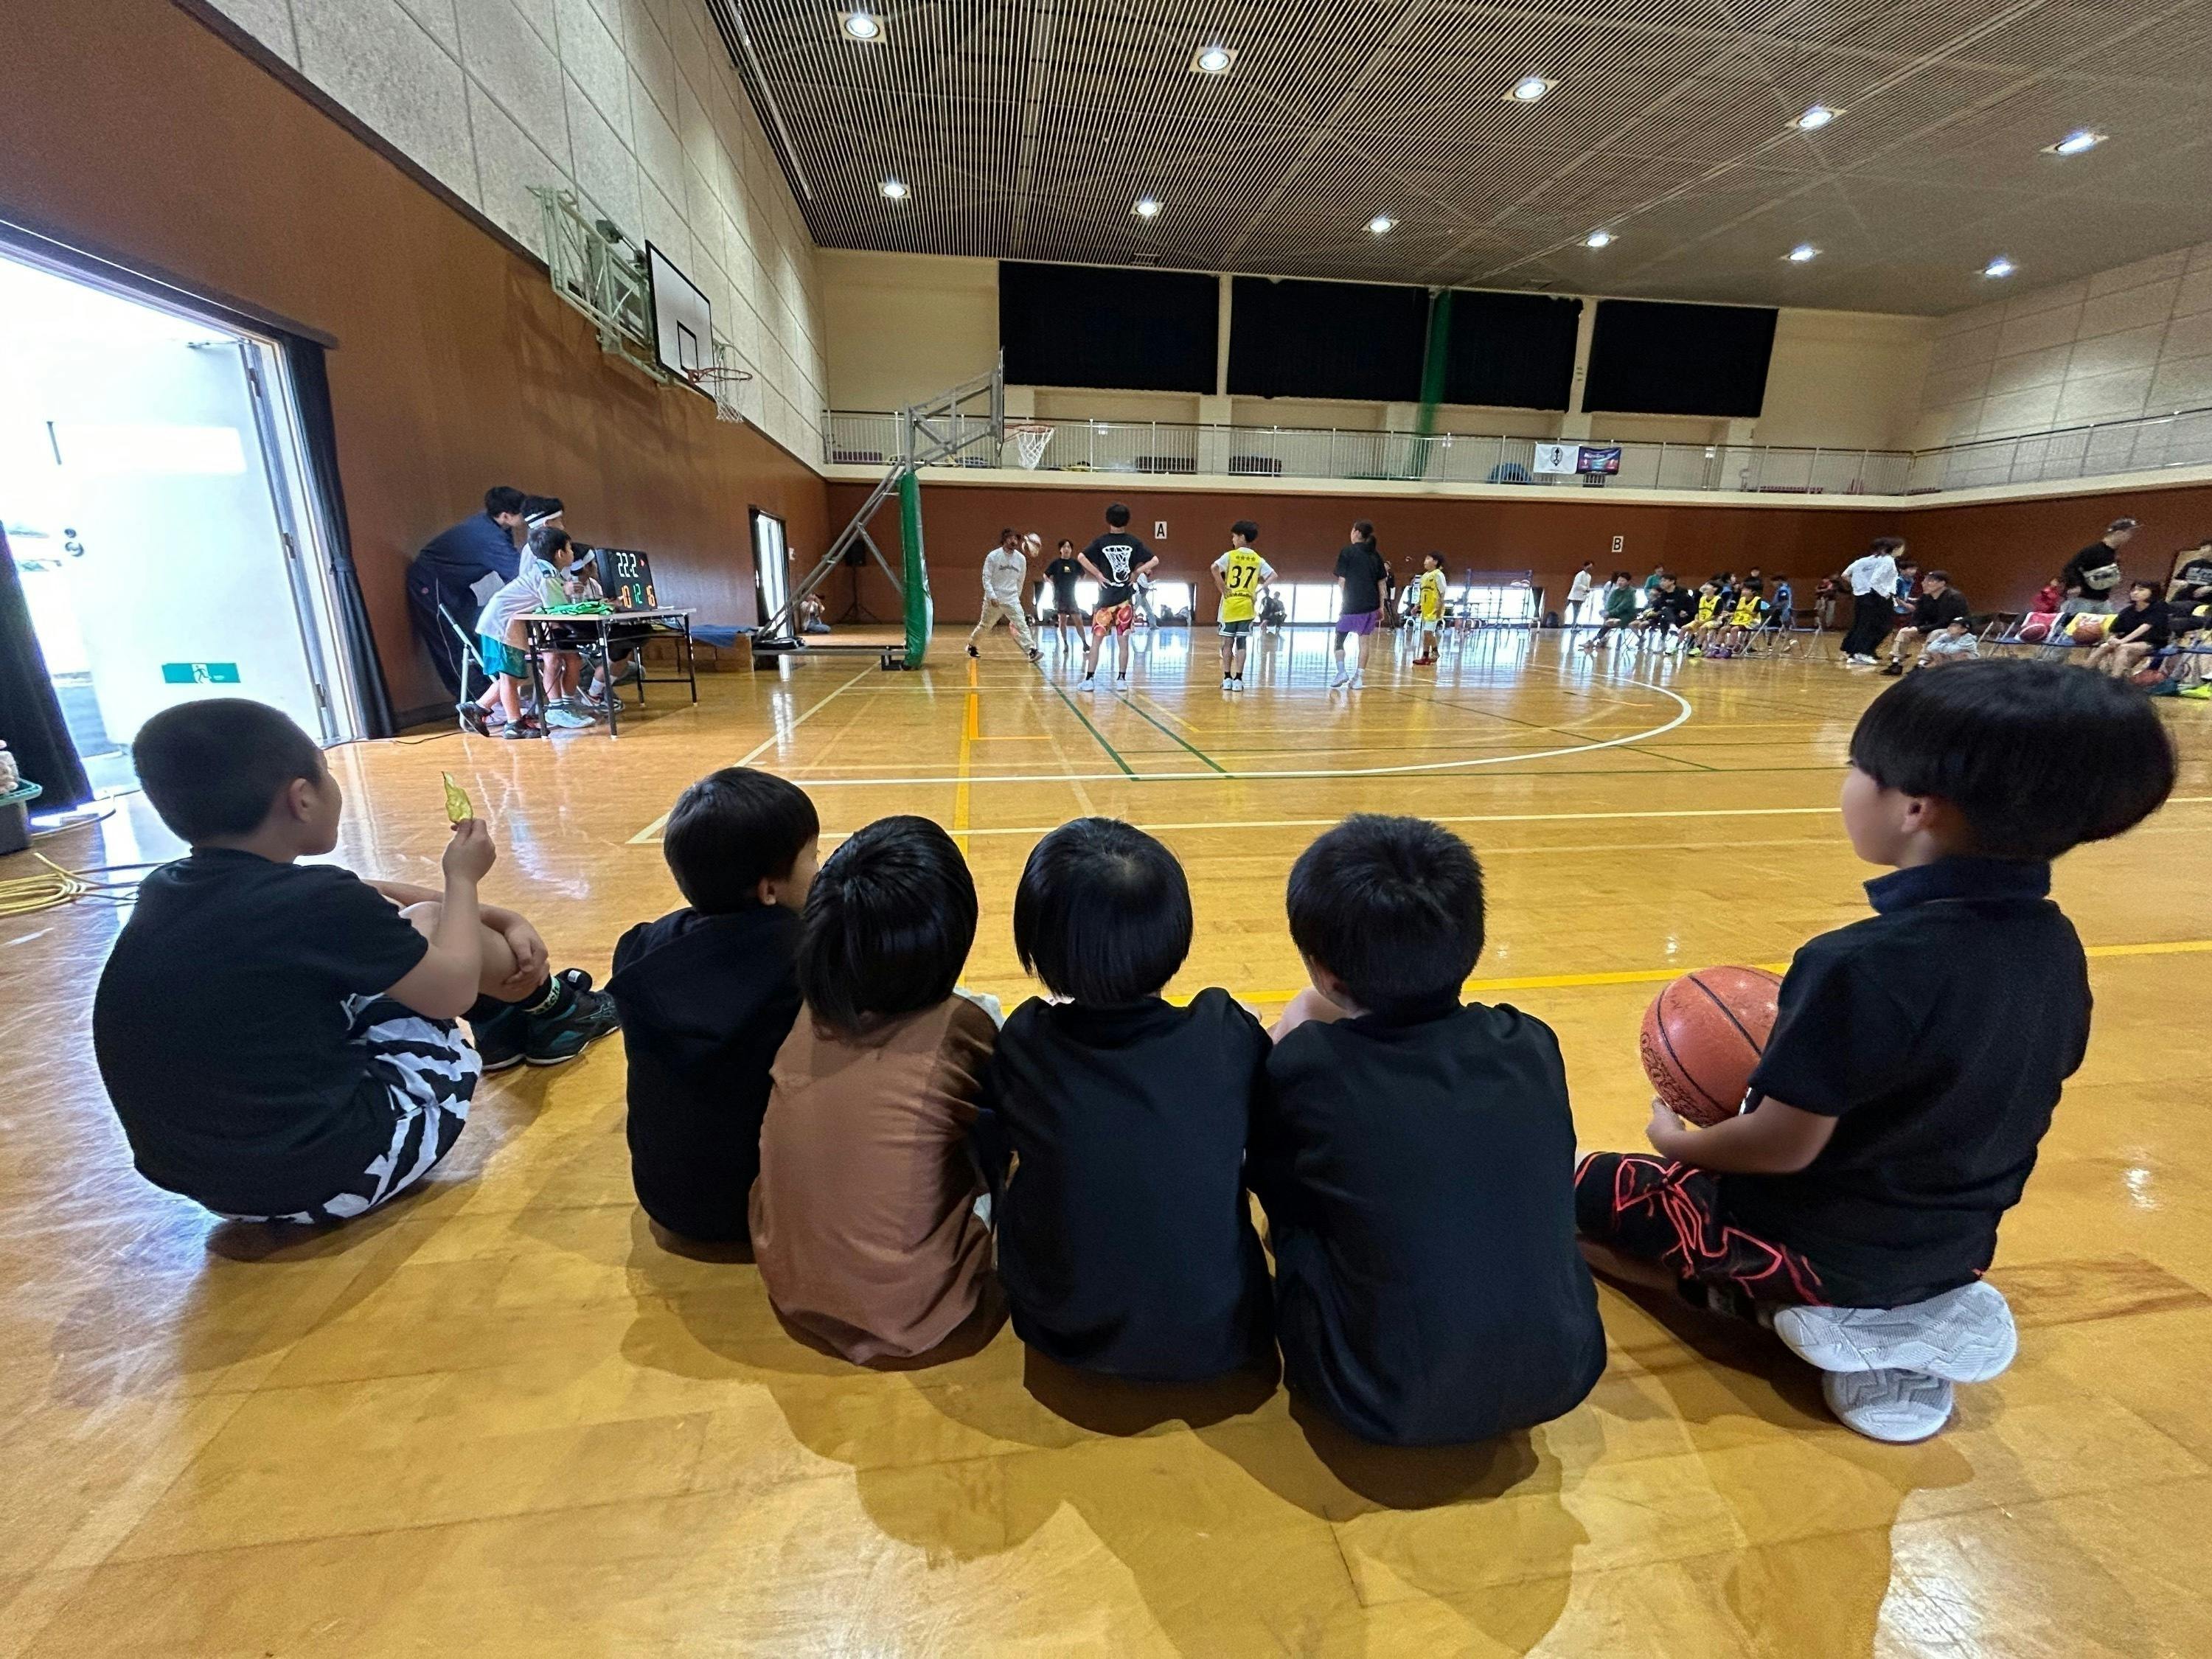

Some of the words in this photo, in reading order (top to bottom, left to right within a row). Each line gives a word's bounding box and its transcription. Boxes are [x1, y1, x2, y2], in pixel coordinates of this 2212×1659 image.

[1157, 524, 1165, 537] A
[1613, 538, 1621, 550] B
[1230, 566, 1256, 588] 37
[633, 583, 643, 604] 12
